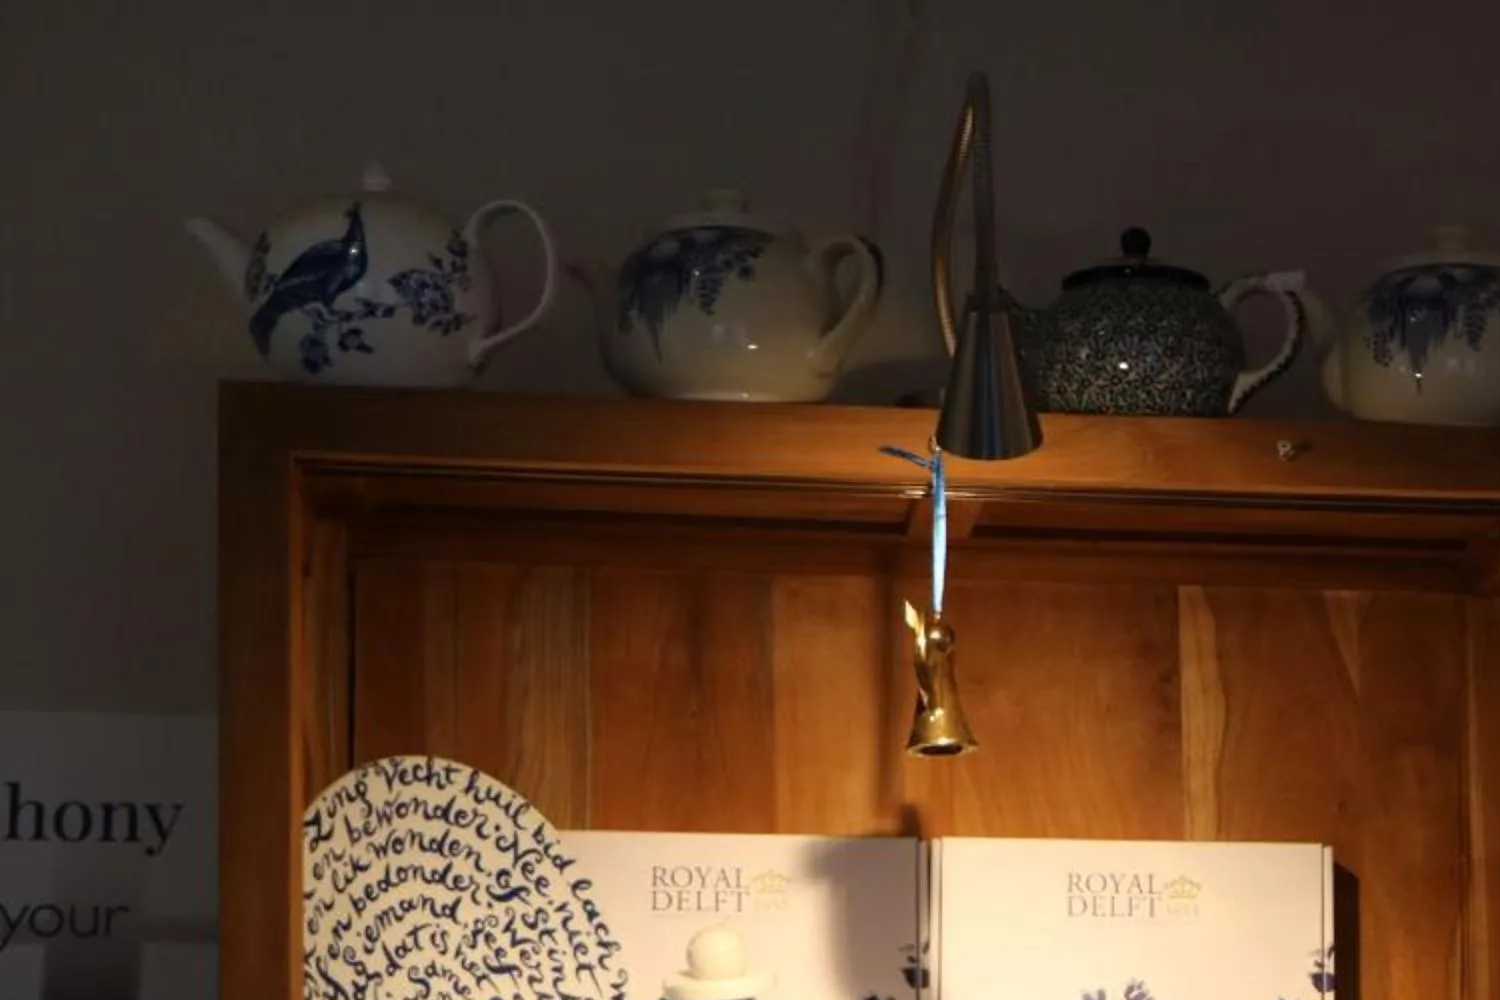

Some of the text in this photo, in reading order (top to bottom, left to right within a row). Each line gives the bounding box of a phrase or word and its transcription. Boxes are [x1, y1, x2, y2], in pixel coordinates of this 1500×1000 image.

[4, 781, 184, 857] hony
[463, 769, 531, 830] huil
[531, 822, 577, 874] bid
[570, 878, 621, 970] lach
[651, 865, 750, 889] ROYAL
[1067, 872, 1162, 895] ROYAL
[651, 889, 750, 912] DELFT
[1067, 895, 1162, 918] DELFT
[0, 903, 130, 951] your
